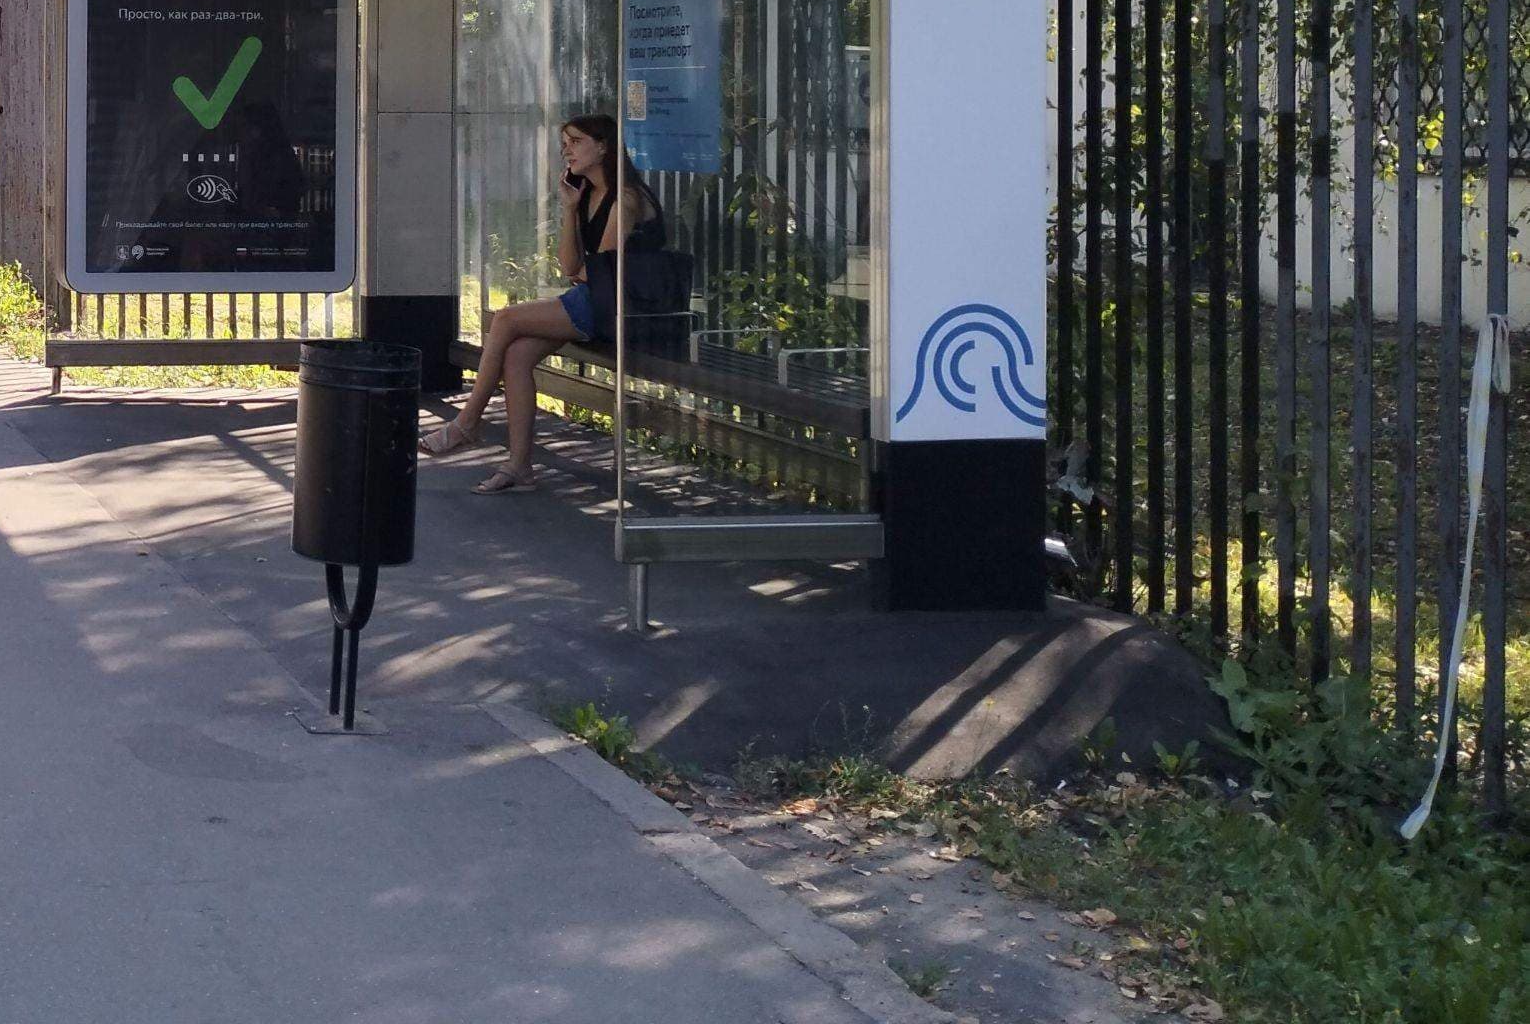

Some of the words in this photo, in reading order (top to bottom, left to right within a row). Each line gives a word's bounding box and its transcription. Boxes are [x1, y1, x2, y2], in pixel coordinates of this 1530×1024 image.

[118, 8, 165, 21] Просто,
[168, 10, 189, 20] как
[190, 11, 264, 22] раз-два-три.
[629, 5, 683, 21] Посмотрите,
[629, 47, 646, 59] ваш
[647, 45, 692, 61] транспорт
